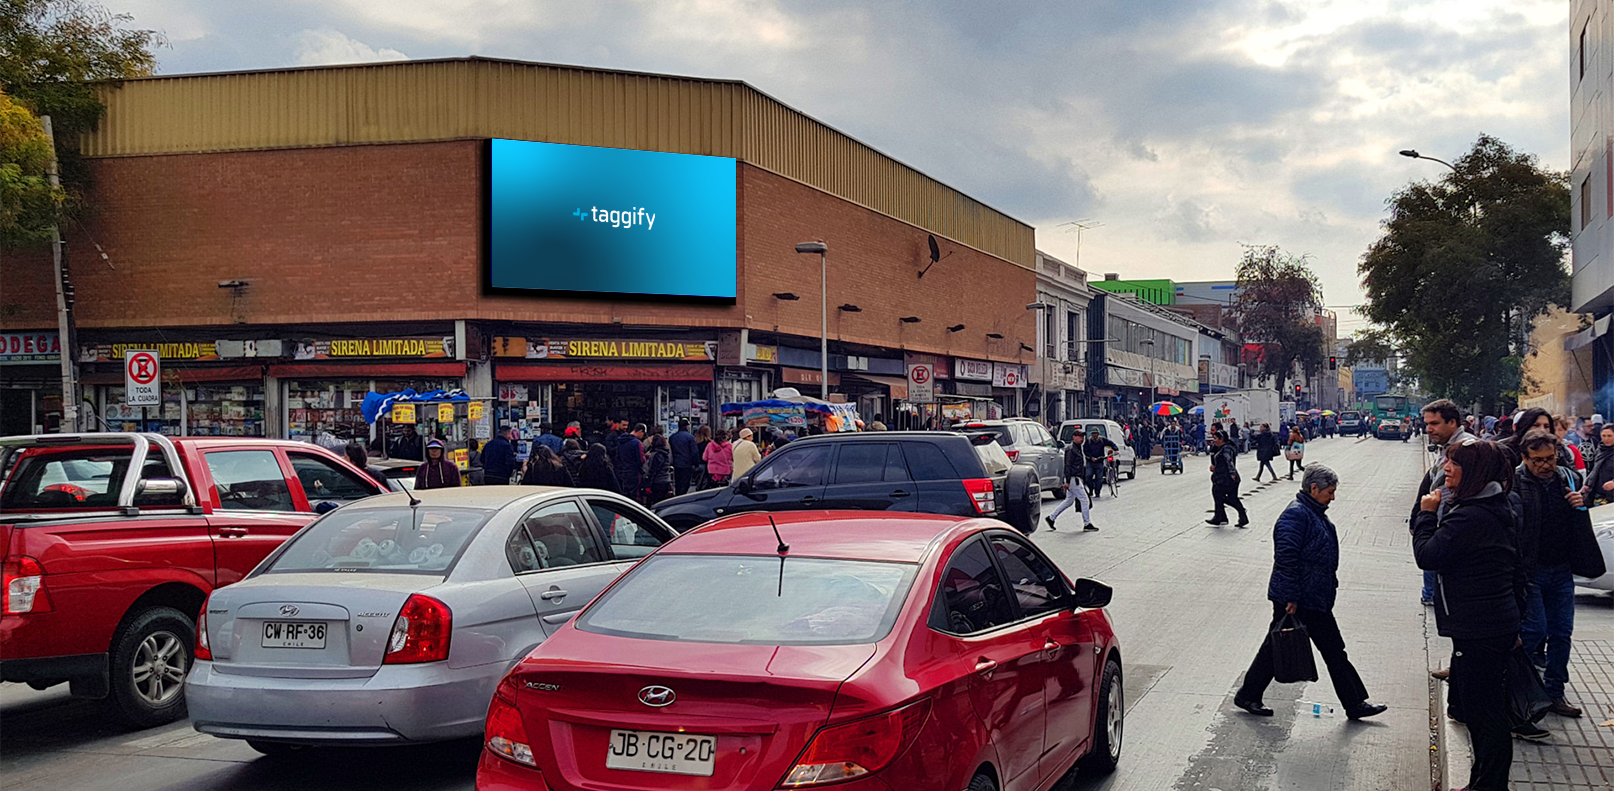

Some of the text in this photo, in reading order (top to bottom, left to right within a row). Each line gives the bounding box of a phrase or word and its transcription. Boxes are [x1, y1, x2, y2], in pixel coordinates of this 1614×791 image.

[591, 206, 656, 230] taggify
[331, 340, 371, 356] SIRENA
[373, 340, 426, 355] LIMITADA
[569, 340, 619, 357] SIRENA
[621, 341, 685, 358] LIMITADA
